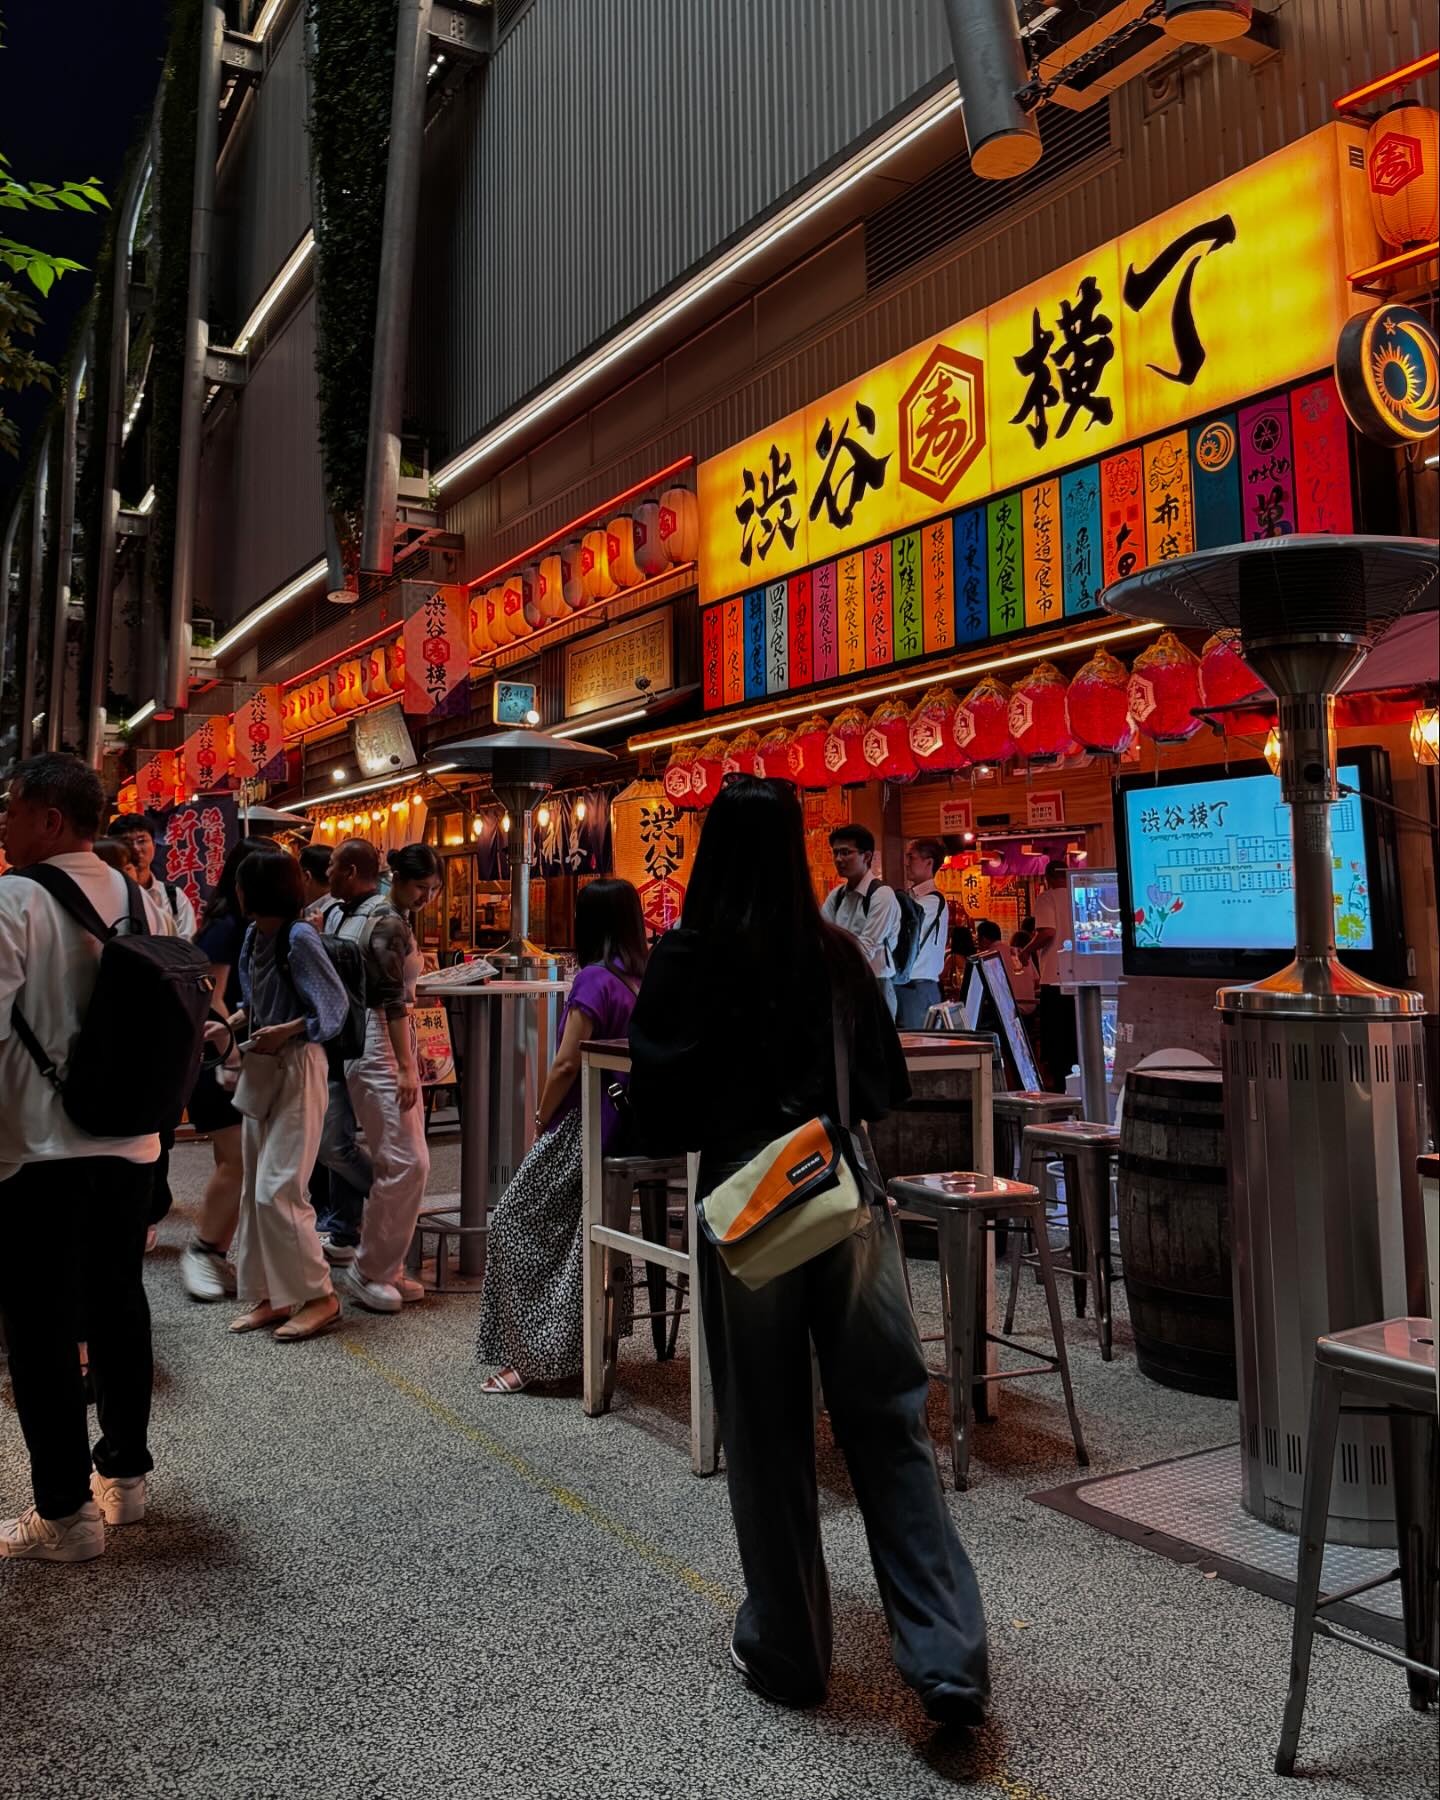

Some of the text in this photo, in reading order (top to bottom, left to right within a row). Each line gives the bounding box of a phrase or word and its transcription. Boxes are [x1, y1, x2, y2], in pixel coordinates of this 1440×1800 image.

[735, 401, 893, 566] 渋谷
[425, 595, 447, 638] 渋谷
[640, 804, 681, 881] 渋谷
[1140, 801, 1229, 833] 渋谷横丁
